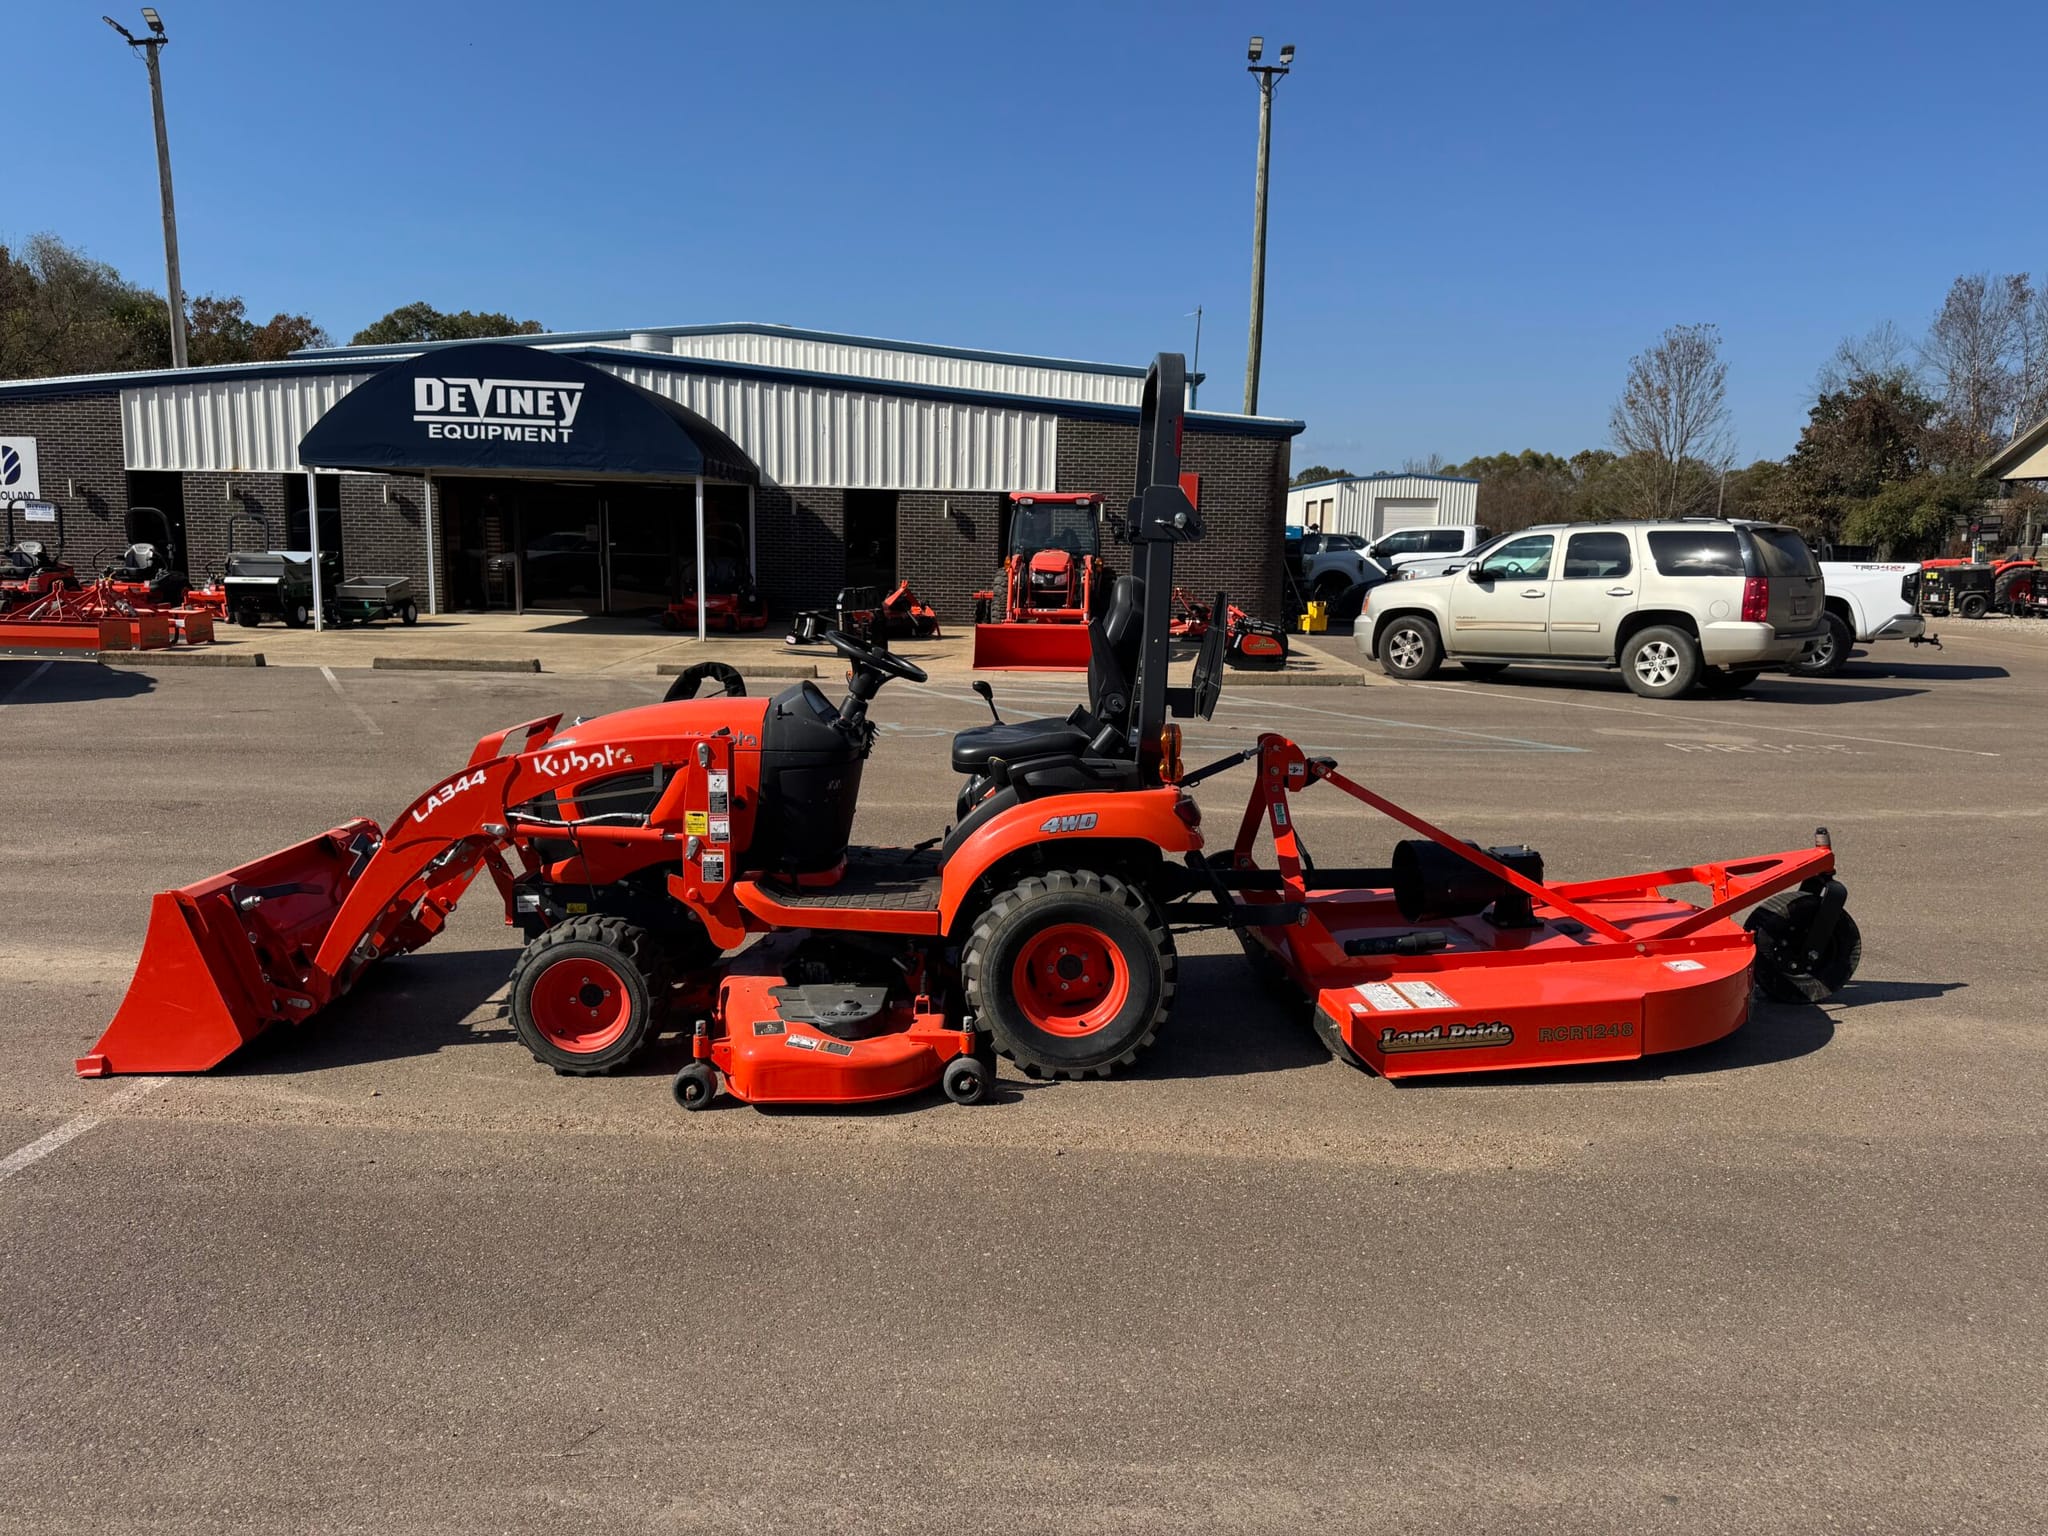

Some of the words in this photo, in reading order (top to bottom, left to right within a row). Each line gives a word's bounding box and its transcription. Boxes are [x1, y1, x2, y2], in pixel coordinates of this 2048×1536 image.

[427, 423, 573, 444] EQUIPMENT
[533, 744, 634, 777] Kubota
[412, 769, 487, 823] LA344
[1040, 812, 1098, 833] 4WD
[1381, 1026, 1441, 1047] Land
[1448, 1022, 1512, 1043] Pride
[1538, 1023, 1634, 1043] RCR1248
